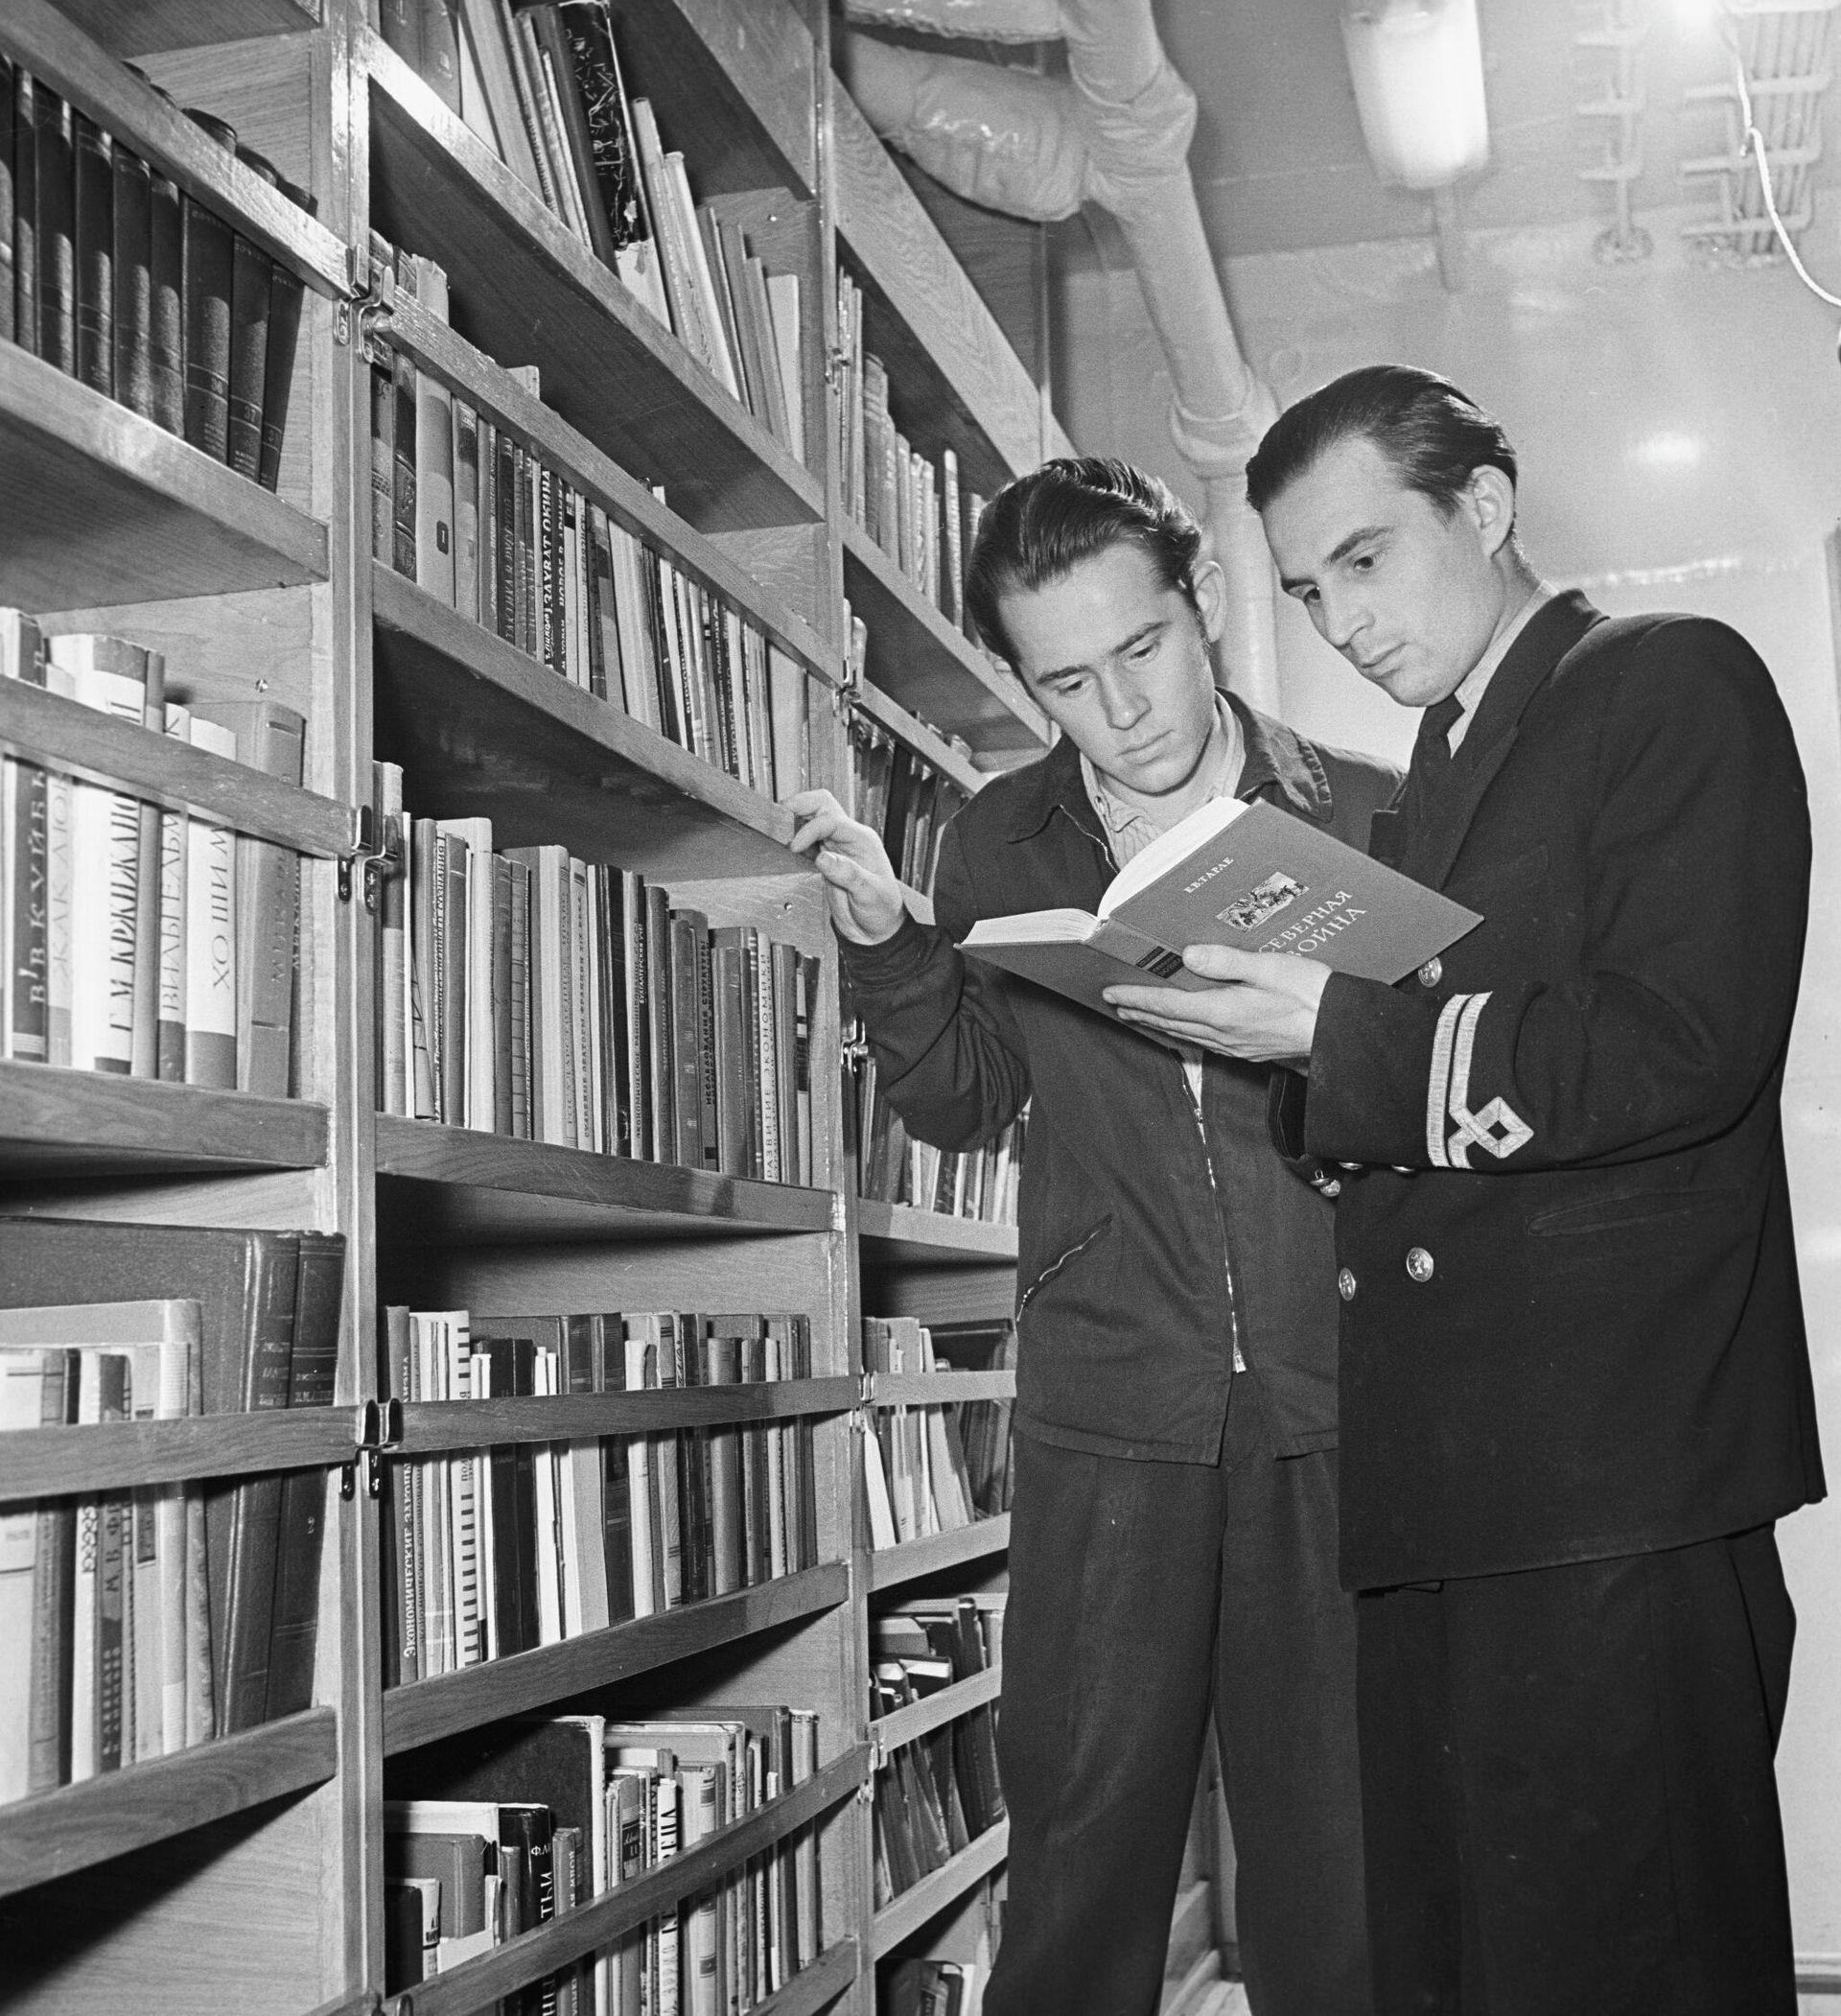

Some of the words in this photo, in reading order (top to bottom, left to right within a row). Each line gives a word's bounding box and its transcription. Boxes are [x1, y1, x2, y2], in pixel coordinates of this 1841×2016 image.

[540, 470, 553, 533] ОКИНА
[542, 533, 553, 605] ЗАХВАТ
[28, 649, 46, 929] КУЙБЫВ
[105, 701, 141, 967] КРЖИЖАНЙ
[52, 880, 69, 982] ЖАК
[161, 813, 181, 1012] ВИЛЬГЕЛЬМ
[209, 864, 230, 923] ШИ
[1257, 889, 1353, 954] СЕВЕРНАЯ
[210, 933, 231, 991] ХО
[703, 1010, 711, 1106] ИССЛЕДОВАНИЯ
[760, 952, 770, 1075] ЭКОНОМИКИ
[764, 1087, 774, 1179] РАЗВИТИЕ
